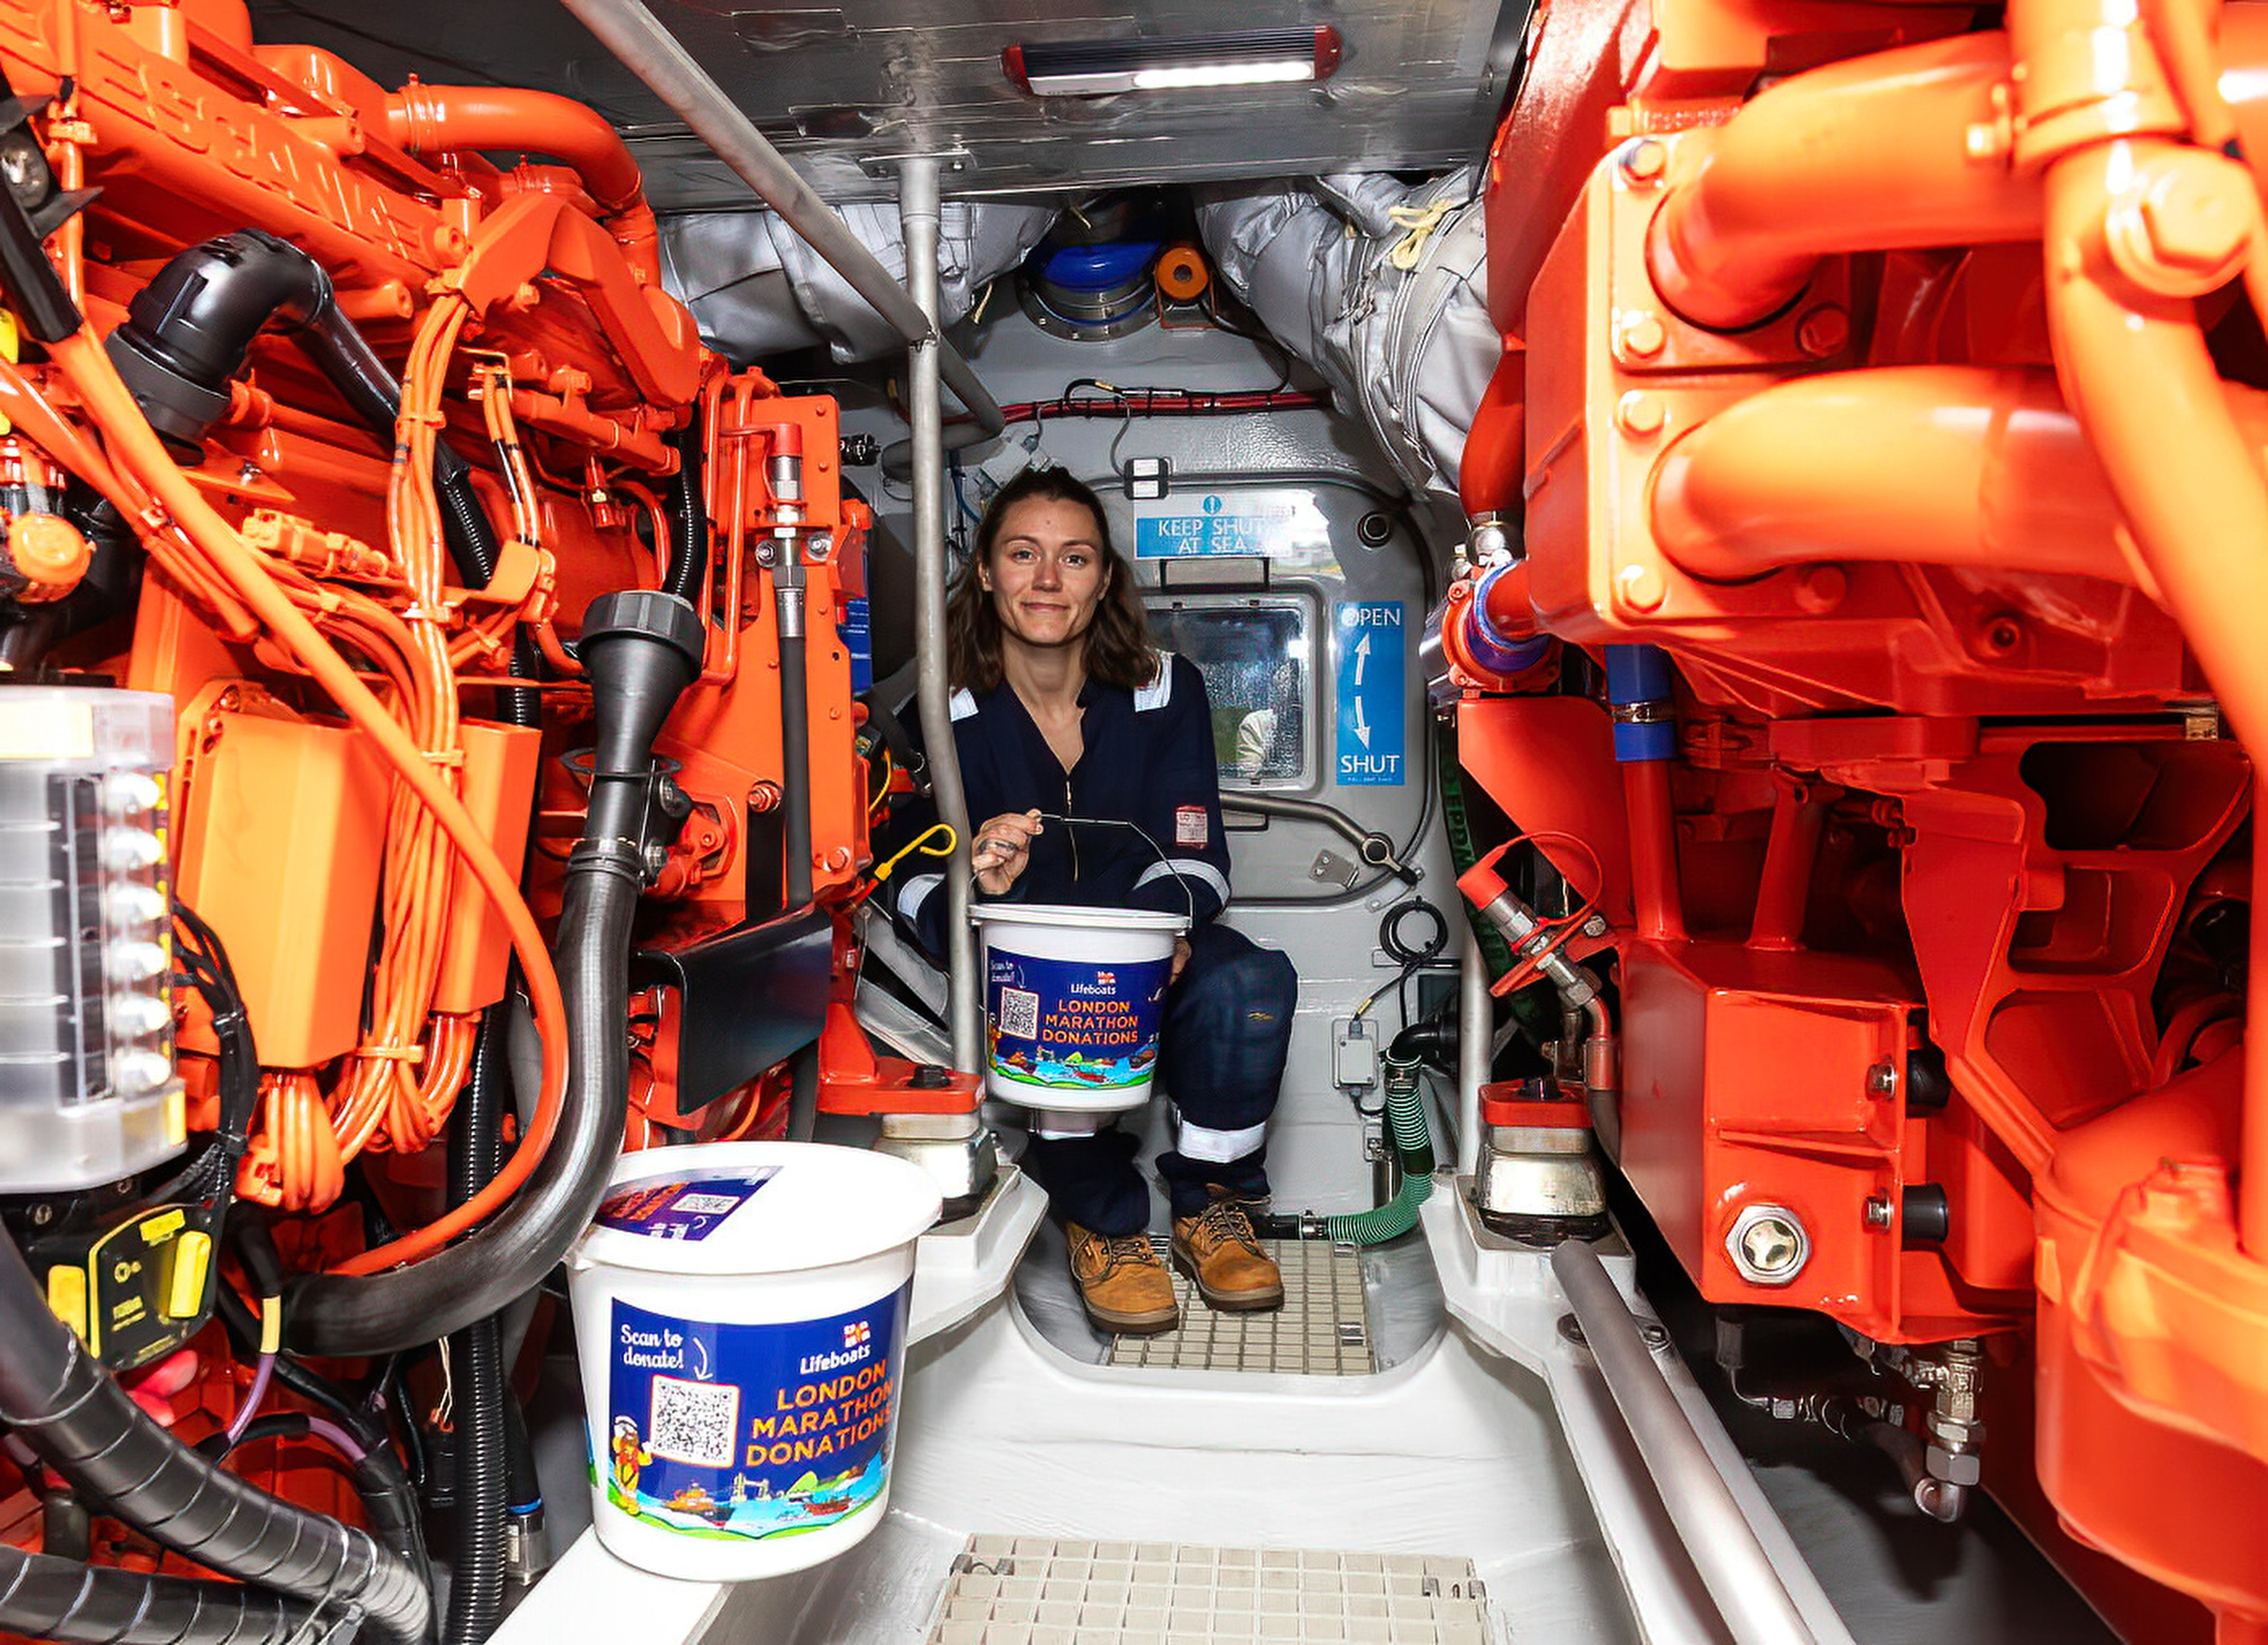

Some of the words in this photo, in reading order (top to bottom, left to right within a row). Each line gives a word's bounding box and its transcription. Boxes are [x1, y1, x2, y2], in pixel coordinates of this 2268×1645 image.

[1158, 518, 1204, 537] KEEP
[1212, 517, 1264, 536] SHUT
[1178, 537, 1201, 554] AT
[1211, 535, 1247, 553] SEA
[1341, 608, 1400, 626] OPEN
[1340, 754, 1400, 773] SHUT
[1070, 983, 1117, 995] Lifeboats
[1059, 999, 1131, 1013] LONDON
[1046, 1014, 1139, 1029] MARATHON
[1043, 1028, 1139, 1045] DONATIONS
[621, 1324, 662, 1347] Scan
[664, 1328, 683, 1347] to
[624, 1346, 684, 1369] donate!
[800, 1345, 871, 1375] Lifeboats
[777, 1359, 886, 1410] LONDON
[752, 1375, 894, 1439] MARATHON
[746, 1401, 893, 1467] DONATIONS
